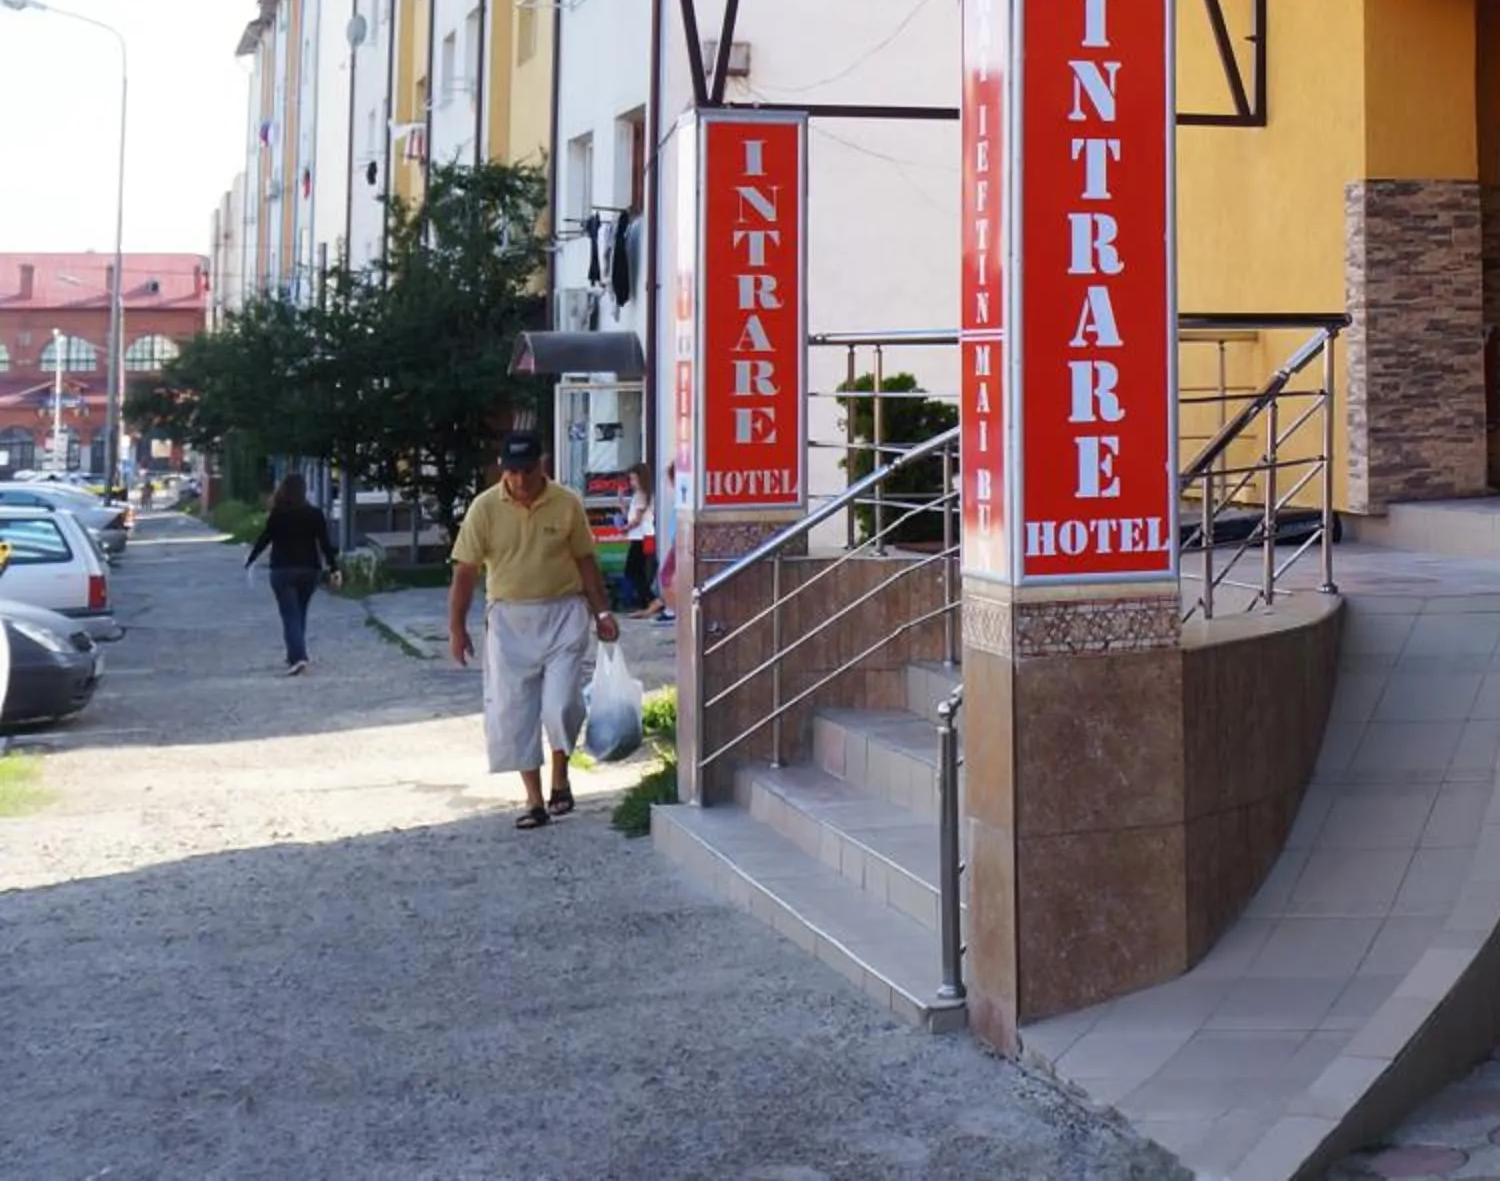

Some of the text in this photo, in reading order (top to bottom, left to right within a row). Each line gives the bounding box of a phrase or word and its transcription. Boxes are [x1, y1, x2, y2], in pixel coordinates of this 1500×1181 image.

[975, 104, 990, 325] IEFTIN
[731, 139, 785, 445] INTRARE
[975, 345, 991, 453] MAI
[705, 468, 797, 496] HOTEL
[1025, 517, 1171, 556] HOTEL
